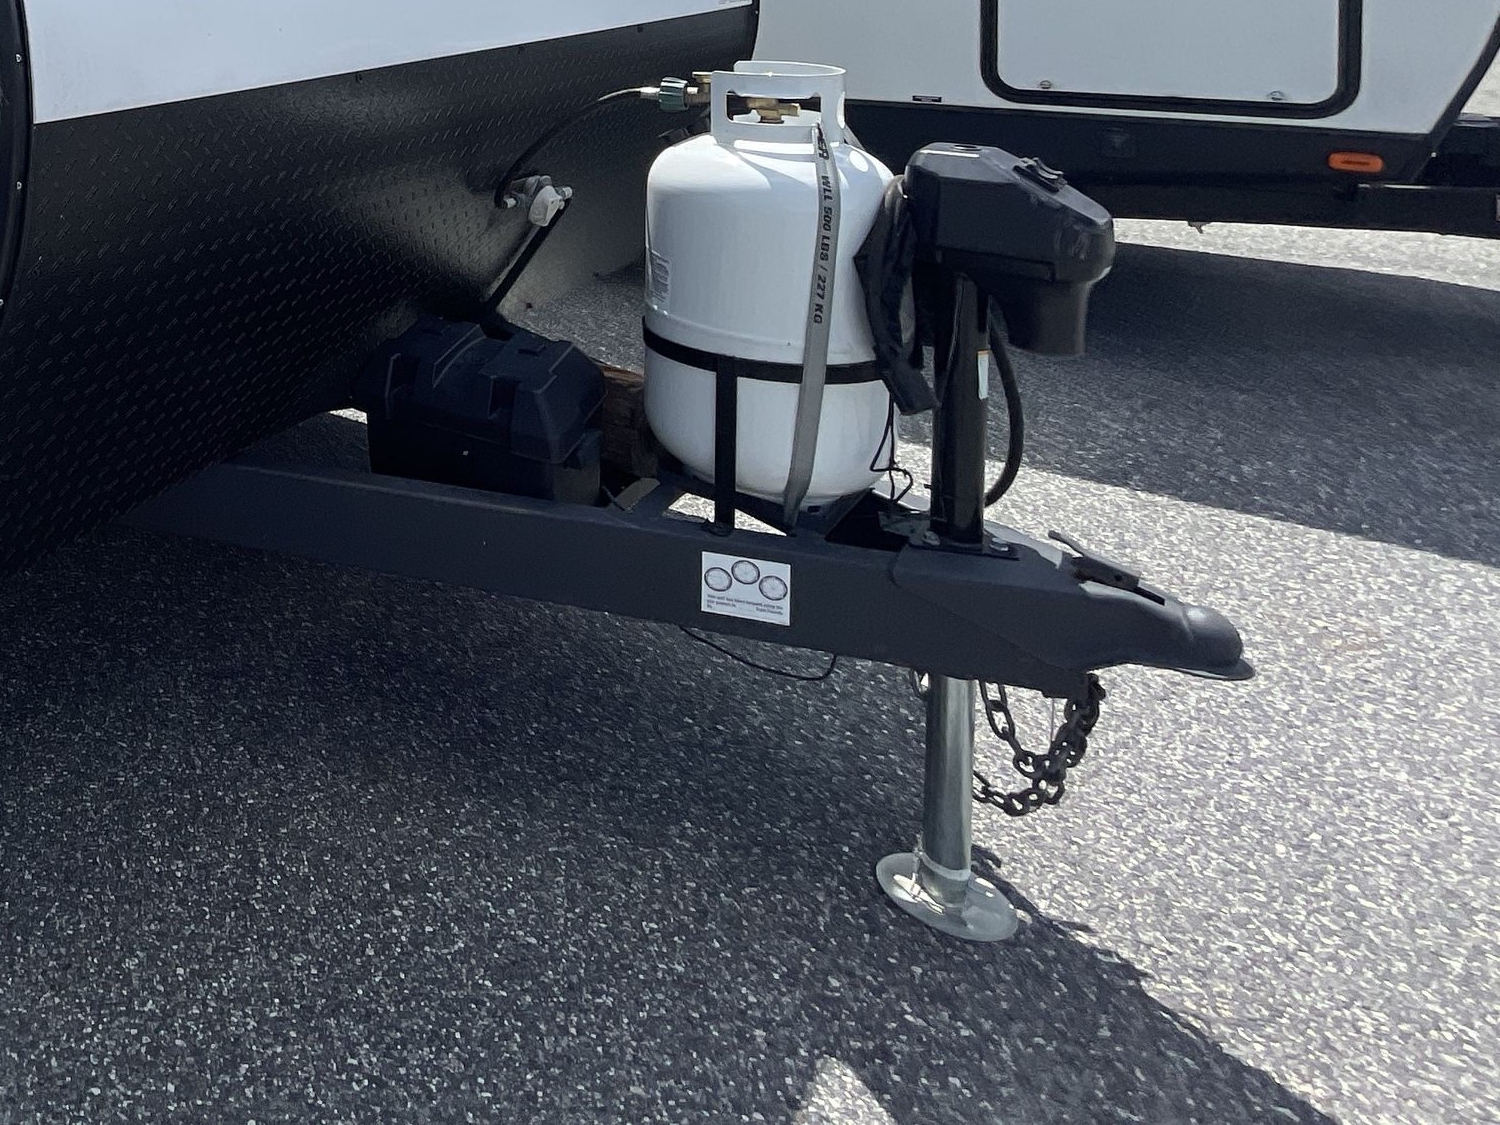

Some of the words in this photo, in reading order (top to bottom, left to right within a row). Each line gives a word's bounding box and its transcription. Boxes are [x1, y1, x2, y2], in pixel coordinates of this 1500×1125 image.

[821, 175, 833, 201] WLL
[822, 206, 833, 232] 500
[819, 235, 831, 261] LBS
[816, 274, 827, 300] 227
[813, 303, 824, 324] KG
